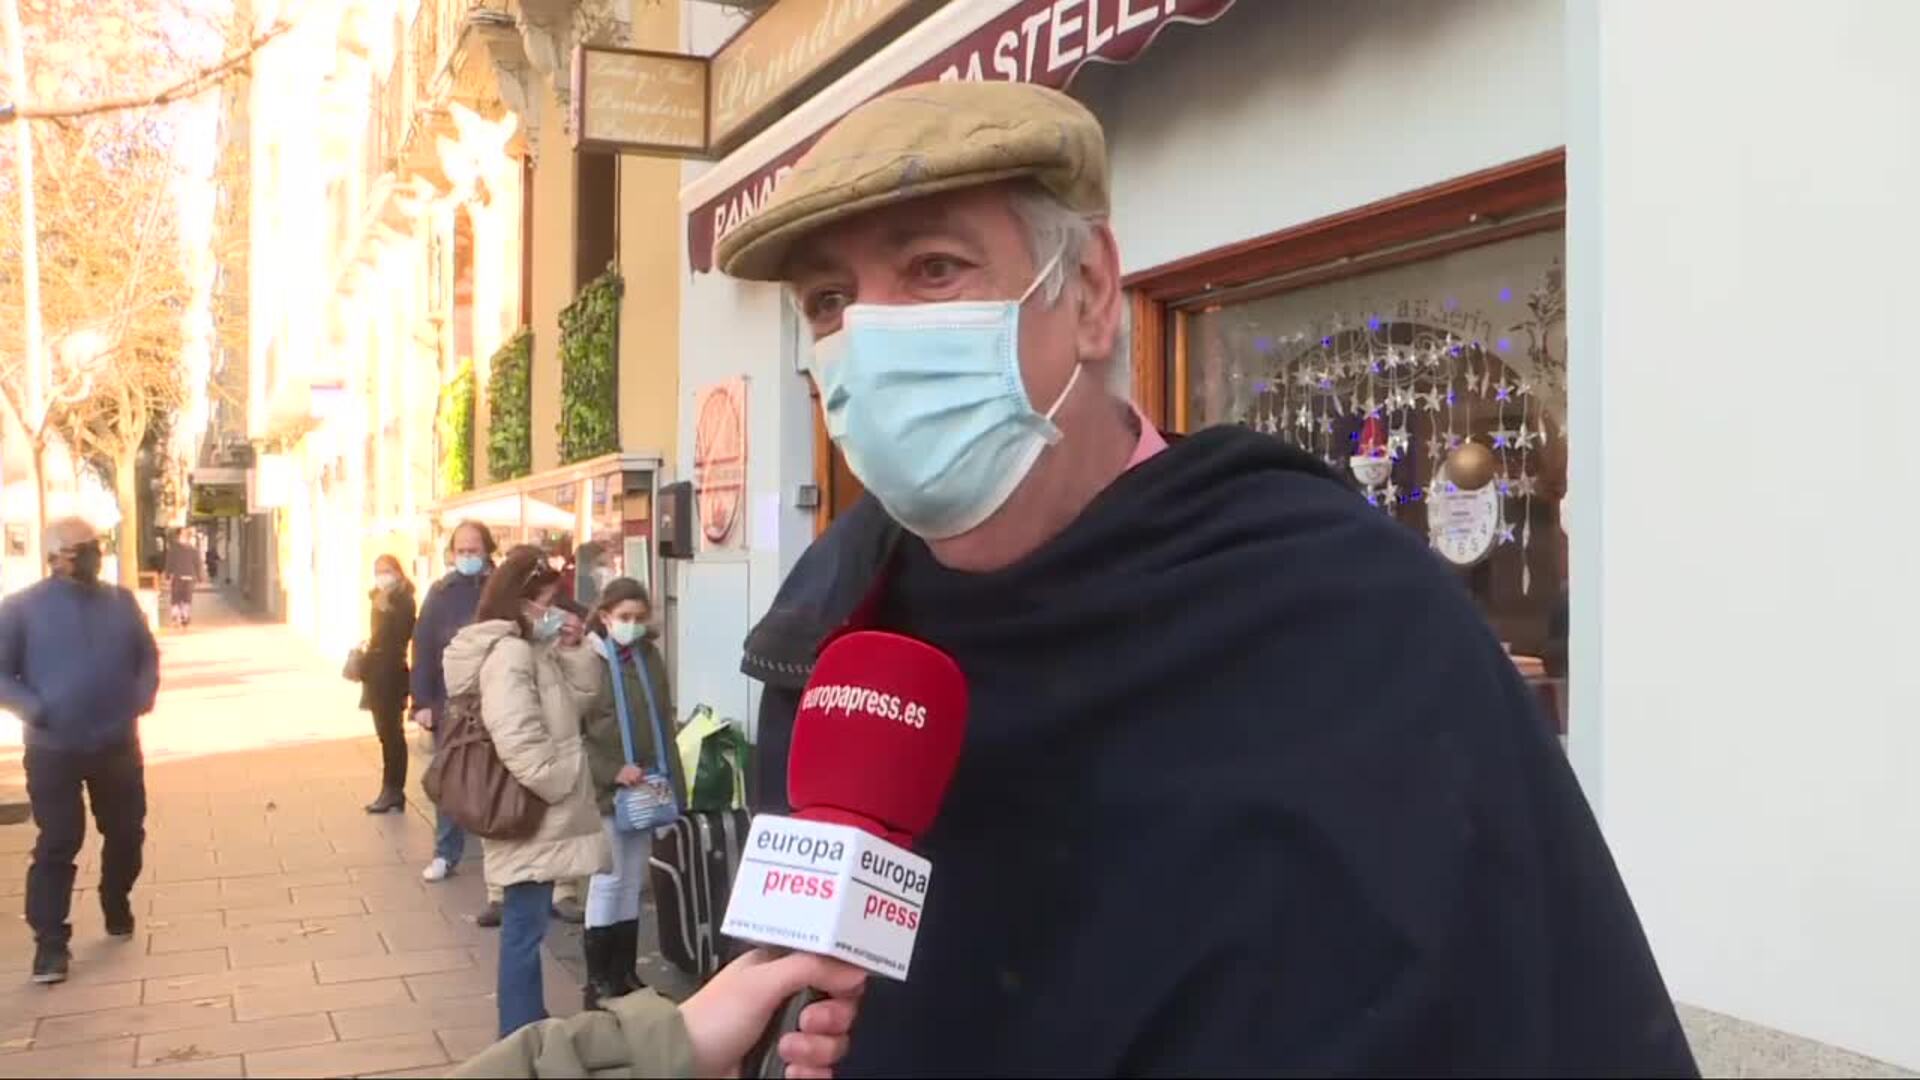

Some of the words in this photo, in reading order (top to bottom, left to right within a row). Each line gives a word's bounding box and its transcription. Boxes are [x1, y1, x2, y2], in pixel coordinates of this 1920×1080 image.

[802, 684, 927, 729] europapress.es
[757, 829, 845, 864] europa
[762, 869, 835, 899] press
[861, 850, 928, 893] europa
[864, 893, 919, 931] press
